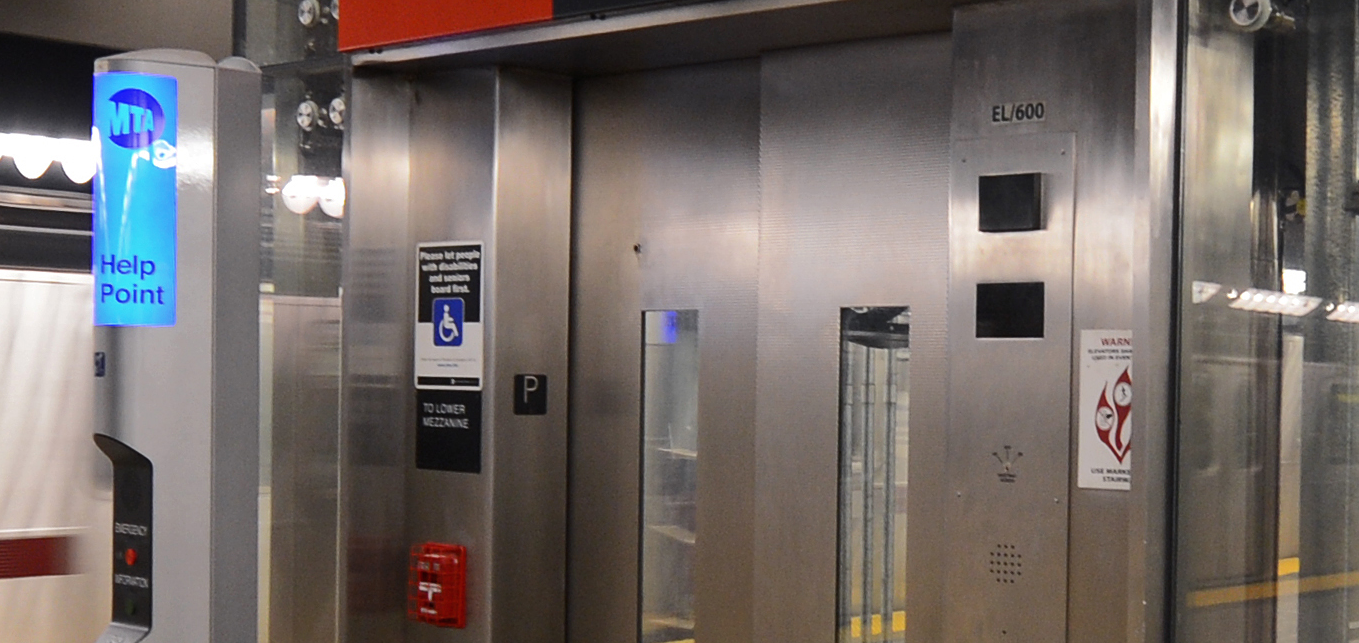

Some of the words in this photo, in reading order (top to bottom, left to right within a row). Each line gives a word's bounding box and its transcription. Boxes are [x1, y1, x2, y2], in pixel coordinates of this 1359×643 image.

[108, 99, 154, 136] MTA
[992, 103, 1044, 122] EL/600
[101, 254, 156, 280] Help
[101, 283, 165, 305] Point
[524, 376, 538, 403] P
[423, 403, 434, 413] TO
[436, 403, 466, 414] LOWER
[423, 417, 469, 429] MEZZANINE
